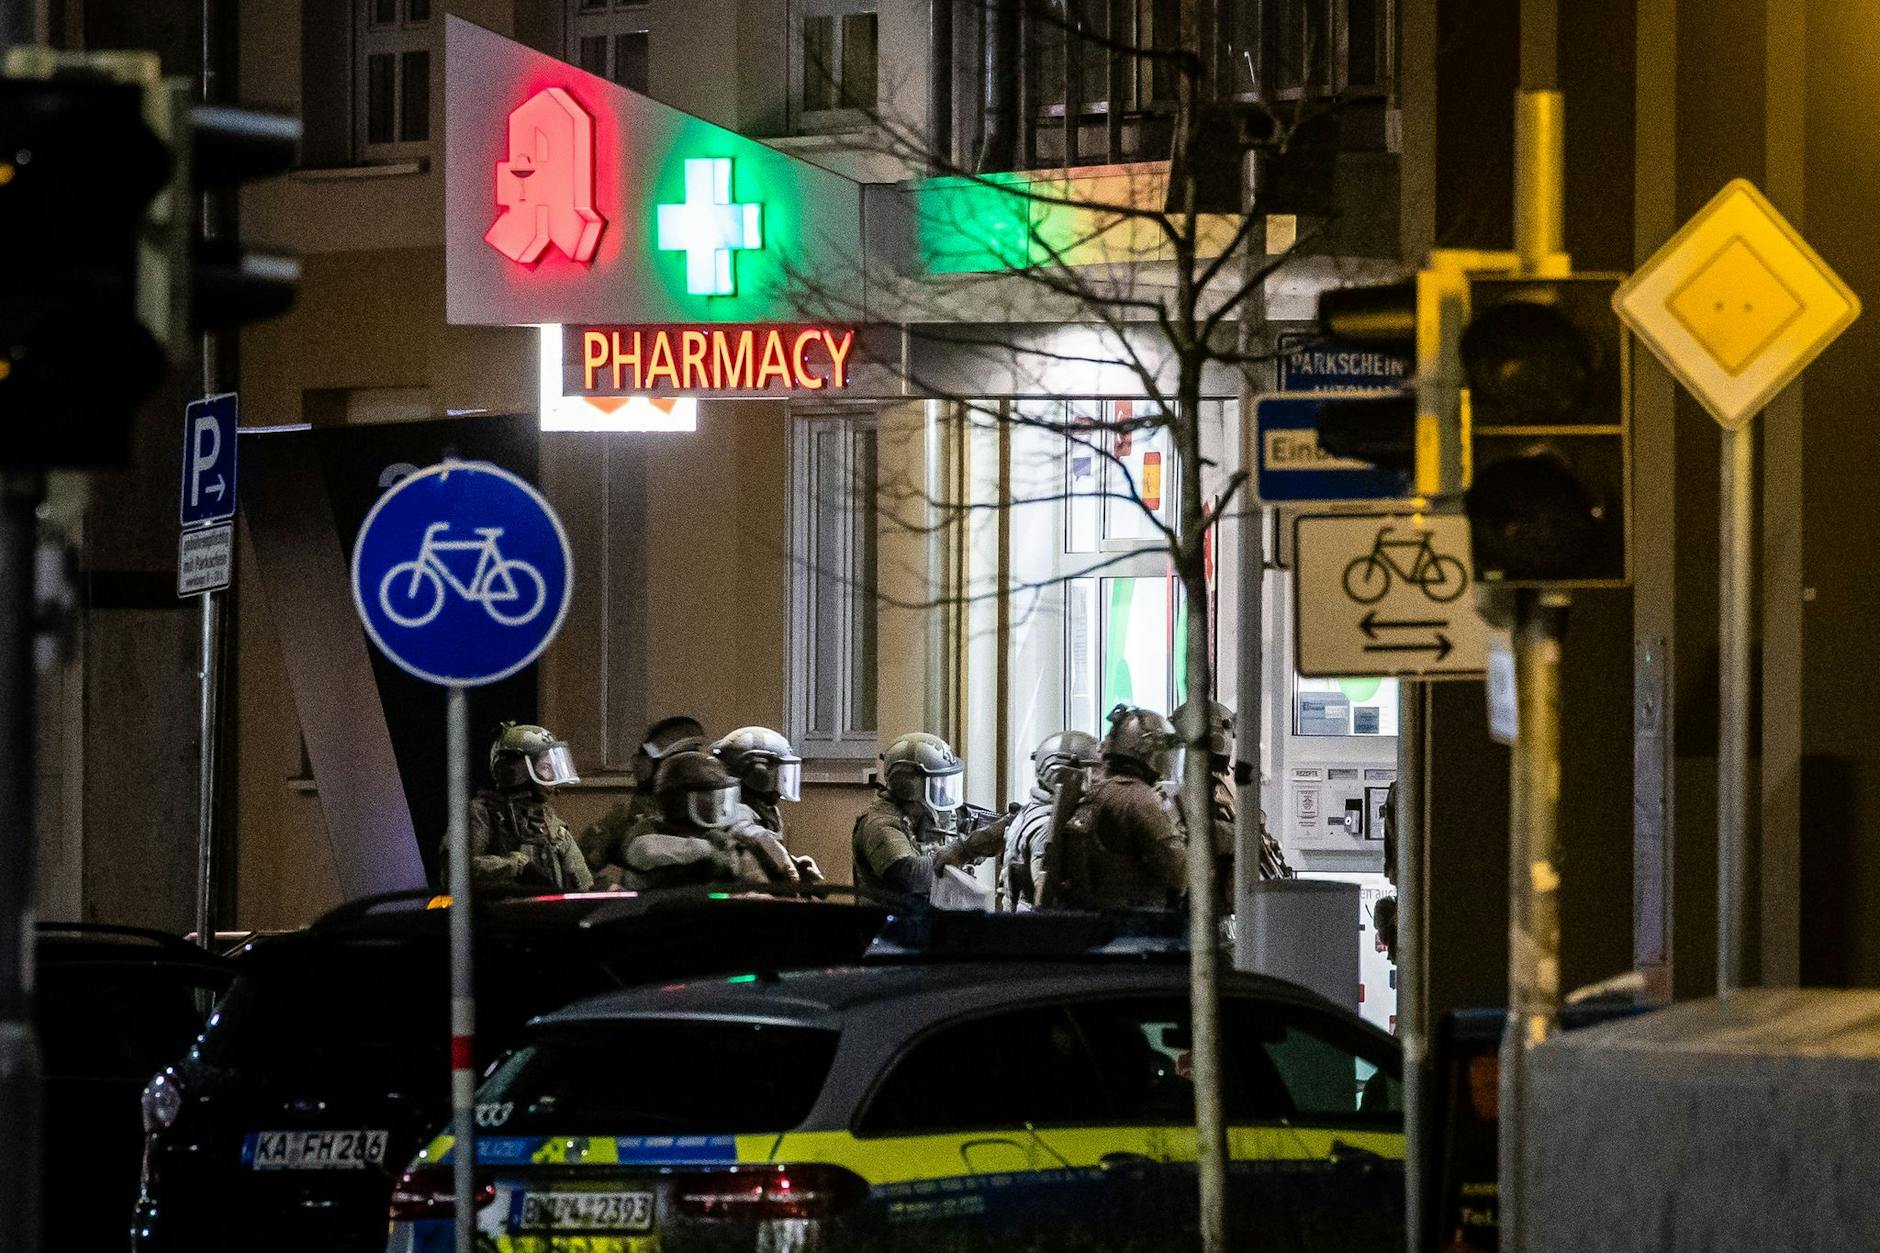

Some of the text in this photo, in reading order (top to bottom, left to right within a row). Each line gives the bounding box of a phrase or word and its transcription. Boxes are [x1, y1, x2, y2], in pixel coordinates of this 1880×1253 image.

[584, 328, 855, 390] PHARMACY
[191, 415, 221, 506] P
[257, 1133, 287, 1160] KA
[302, 1133, 334, 1160] FH
